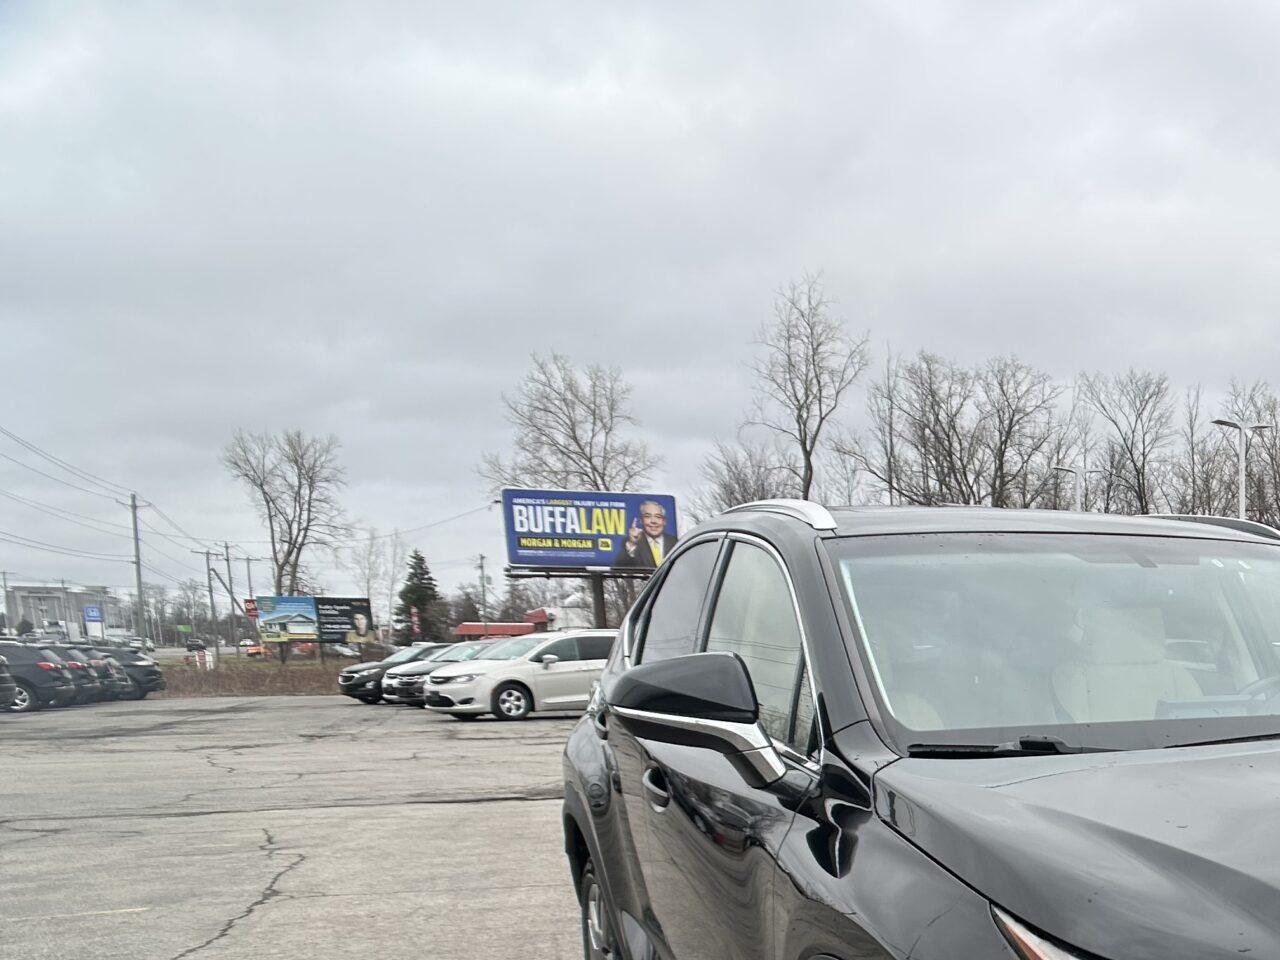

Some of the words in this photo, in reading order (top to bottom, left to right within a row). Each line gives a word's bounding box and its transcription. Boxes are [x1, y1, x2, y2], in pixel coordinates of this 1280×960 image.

[512, 504, 626, 535] BUFFALAW
[520, 537, 552, 547] MORGAN
[561, 539, 593, 548] MORGAN
